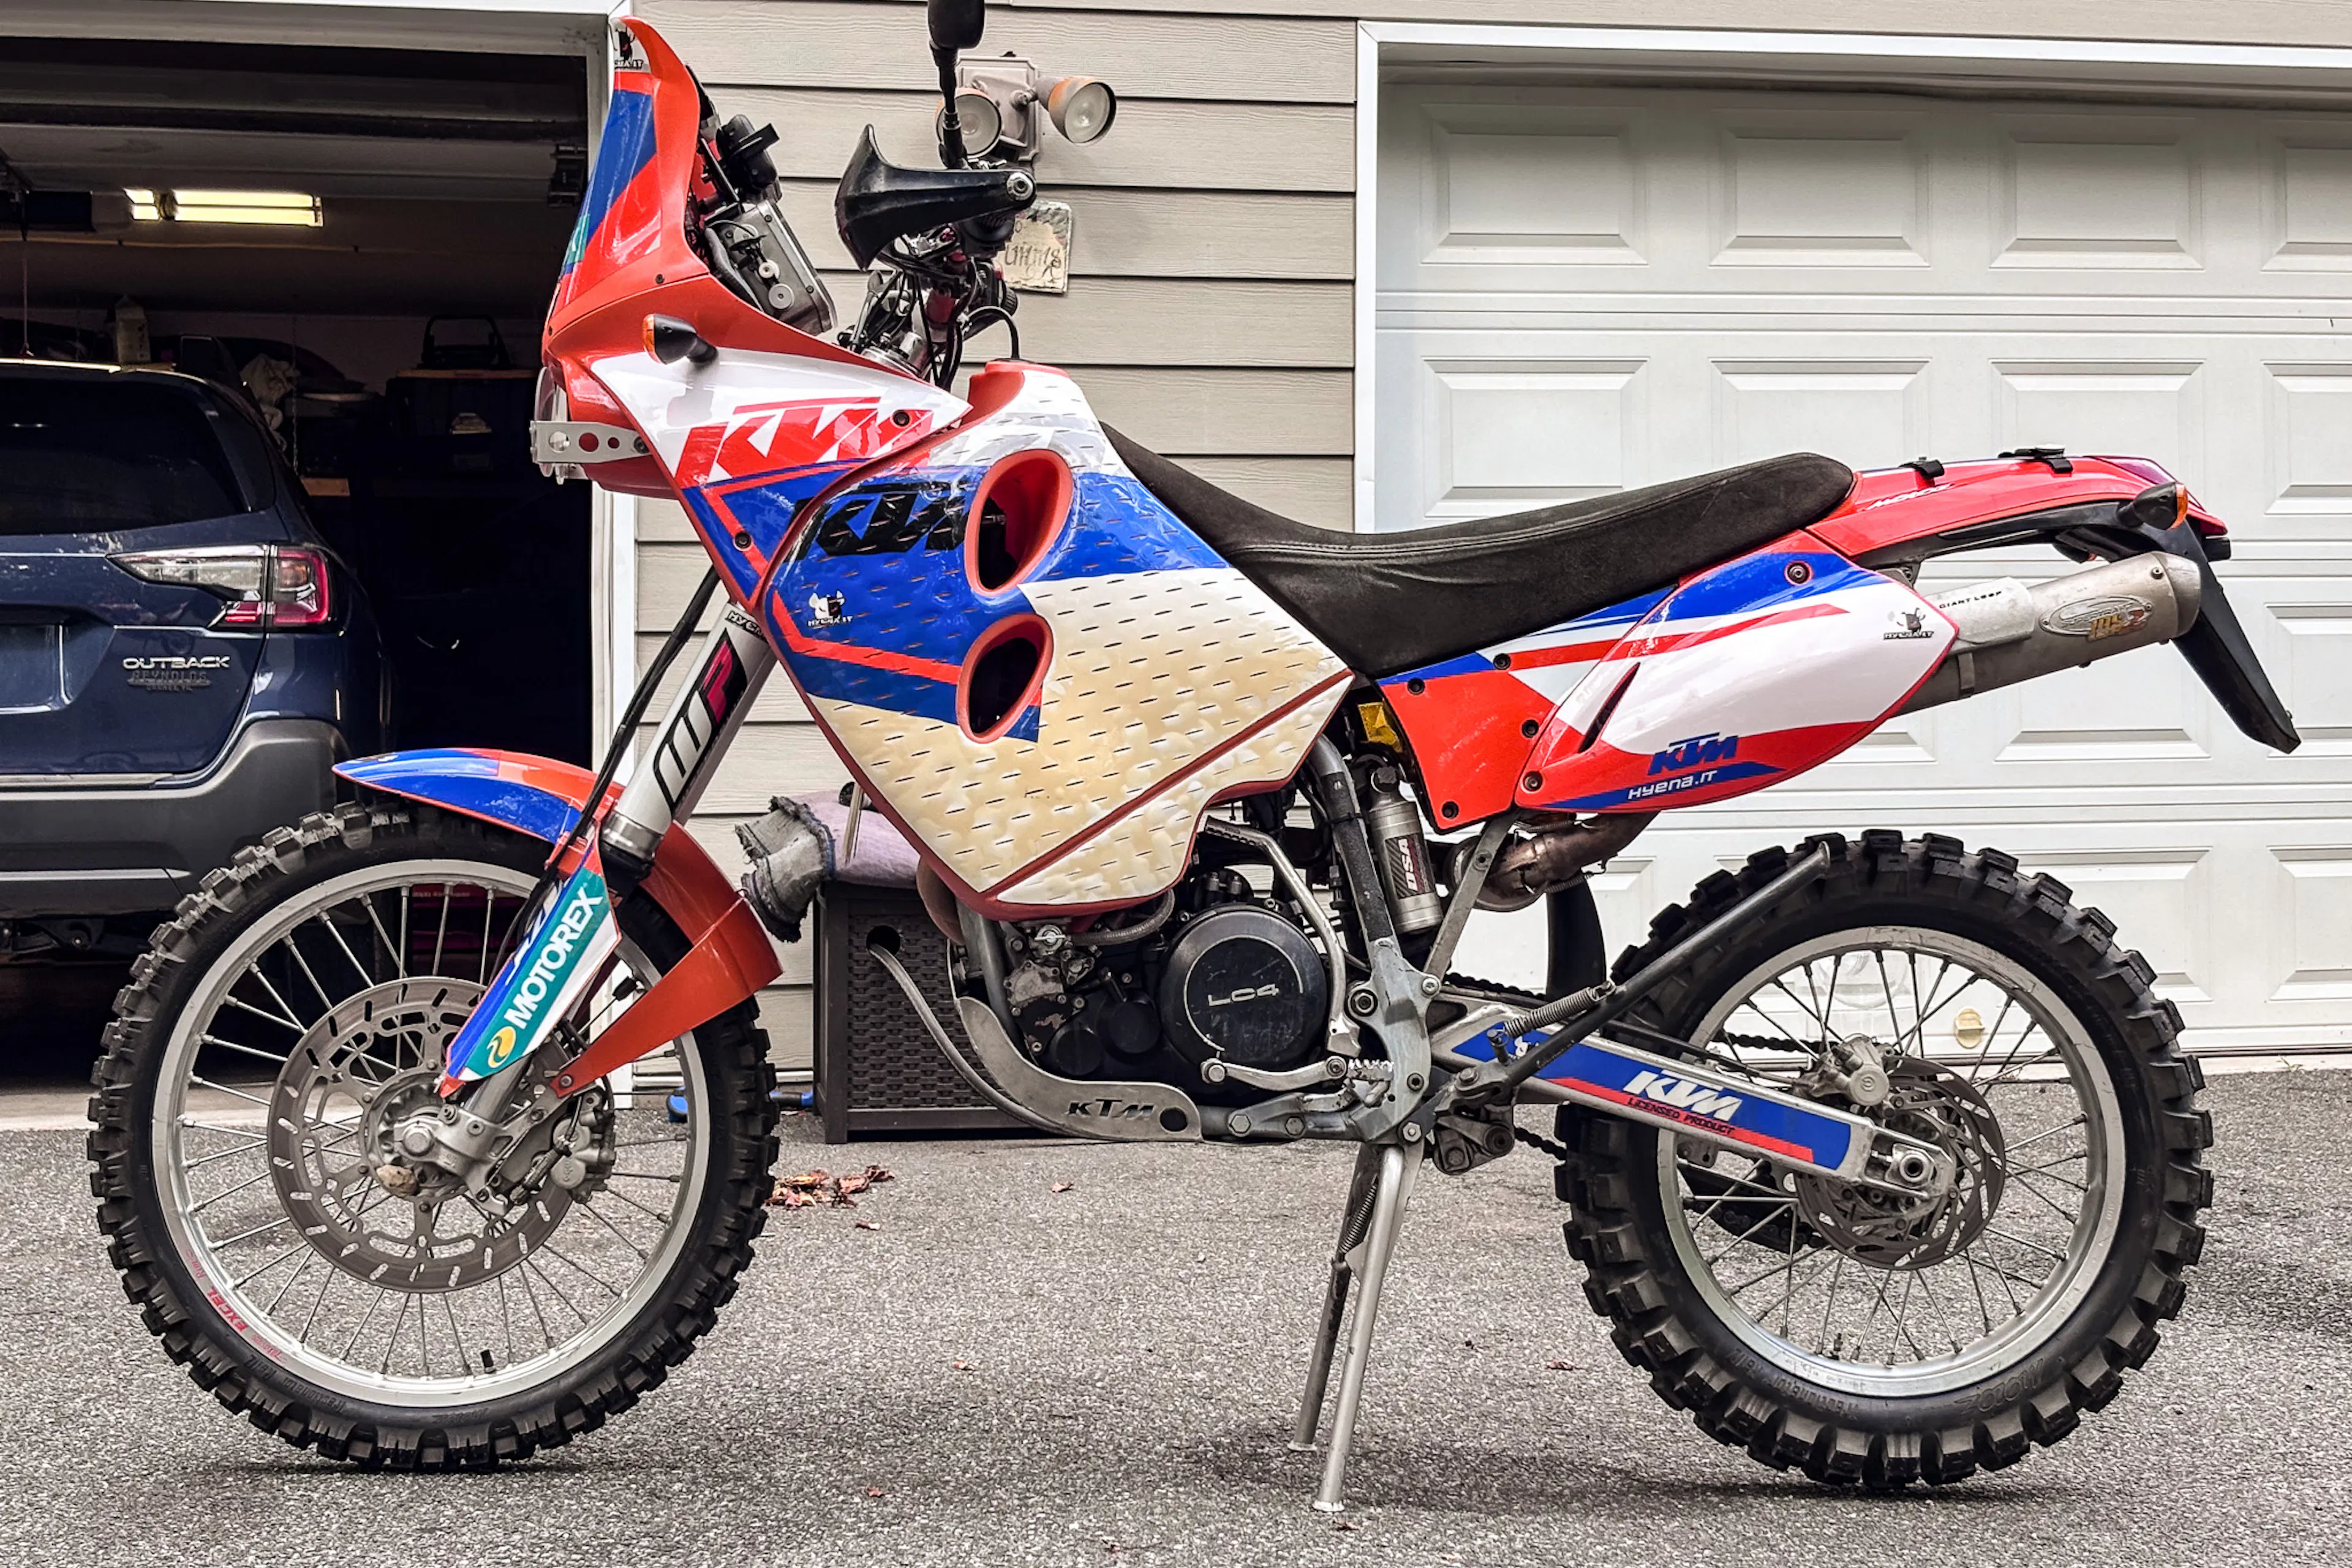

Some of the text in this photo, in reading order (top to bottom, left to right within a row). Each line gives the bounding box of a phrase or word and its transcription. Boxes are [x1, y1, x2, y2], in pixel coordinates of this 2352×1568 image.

[1939, 598, 1970, 609] GIANT
[123, 656, 230, 669] OUTBACK
[1648, 732, 1738, 776] KTM
[503, 886, 603, 1030] MOTOREX
[1207, 983, 1280, 1007] LC4
[1623, 1069, 1743, 1122] KTM
[1068, 1098, 1155, 1121] KTM
[1684, 1114, 1735, 1135] PRODUCT
[207, 1286, 248, 1333] EXCEL
